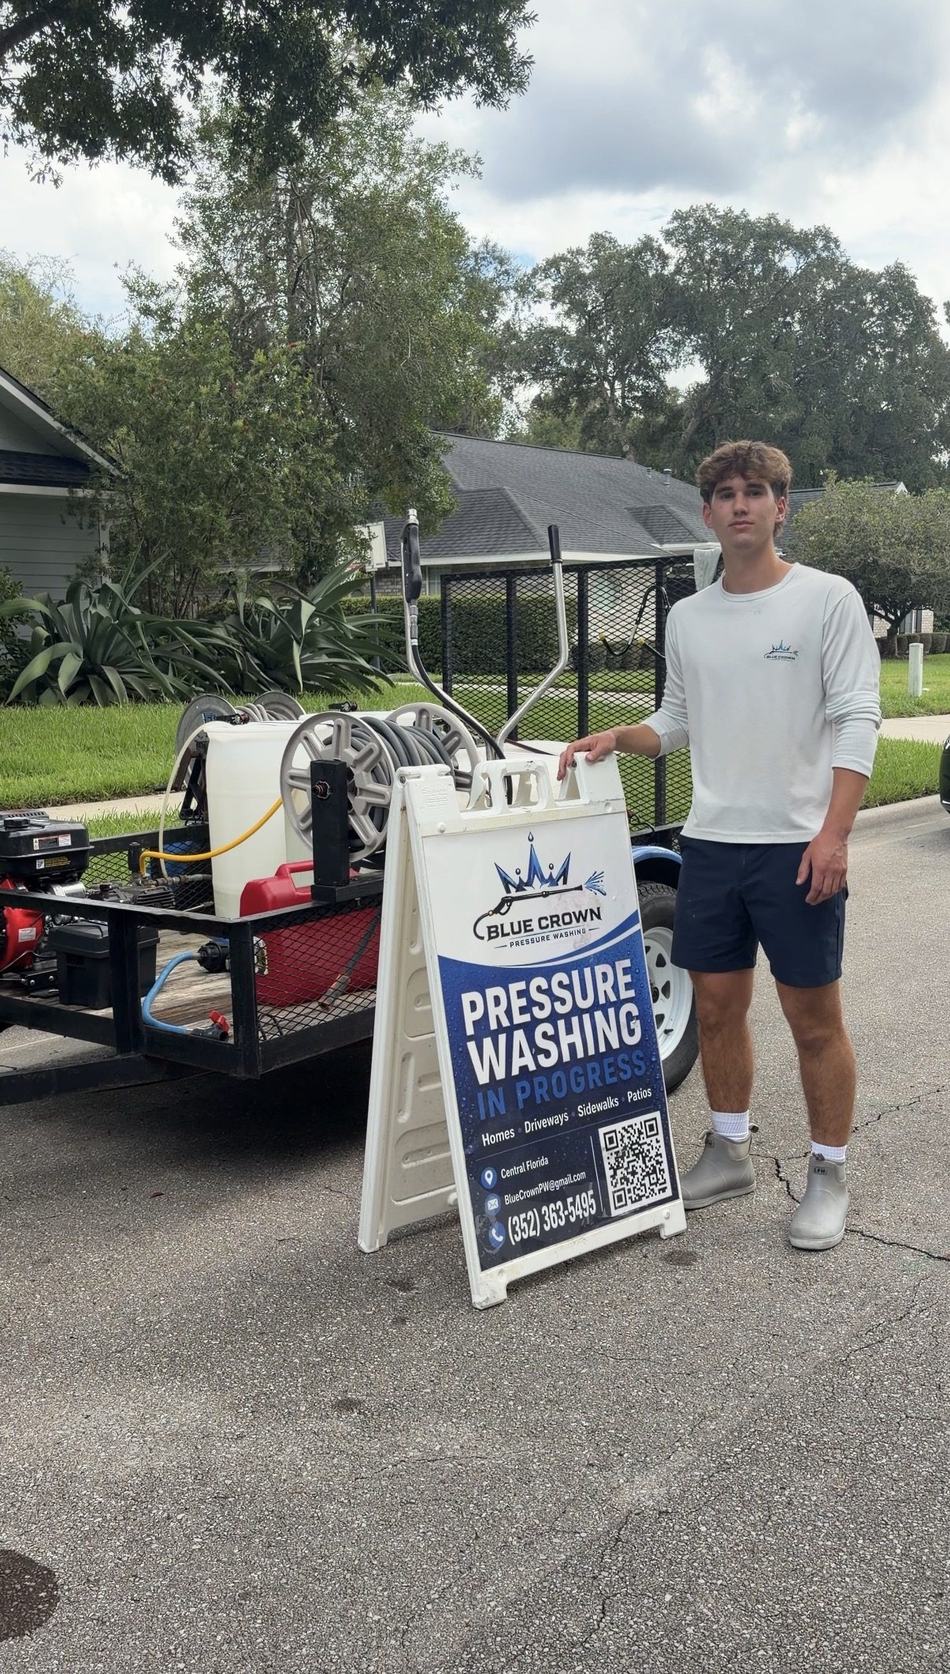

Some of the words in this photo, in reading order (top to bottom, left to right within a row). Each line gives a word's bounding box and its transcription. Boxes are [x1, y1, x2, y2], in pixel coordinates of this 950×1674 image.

[486, 918, 534, 942] BLUE
[537, 906, 602, 931] CROWN
[509, 934, 550, 948] PRESSURE
[552, 928, 586, 941] WASHING
[461, 958, 636, 1036] PRESSURE
[466, 1002, 642, 1085] WASHING
[476, 1086, 507, 1121] IN
[515, 1050, 647, 1110] PROGRESS
[481, 1127, 515, 1147] Homes
[524, 1111, 569, 1134] Driveways
[577, 1096, 619, 1118] Sidewalks
[627, 1087, 652, 1103] Patios
[500, 1162, 526, 1179] Central
[526, 1155, 549, 1172] Florida
[504, 1170, 587, 1206] BlueCrownPW@gmail.com
[507, 1208, 540, 1246] (352)
[543, 1190, 597, 1232] 363-5495
